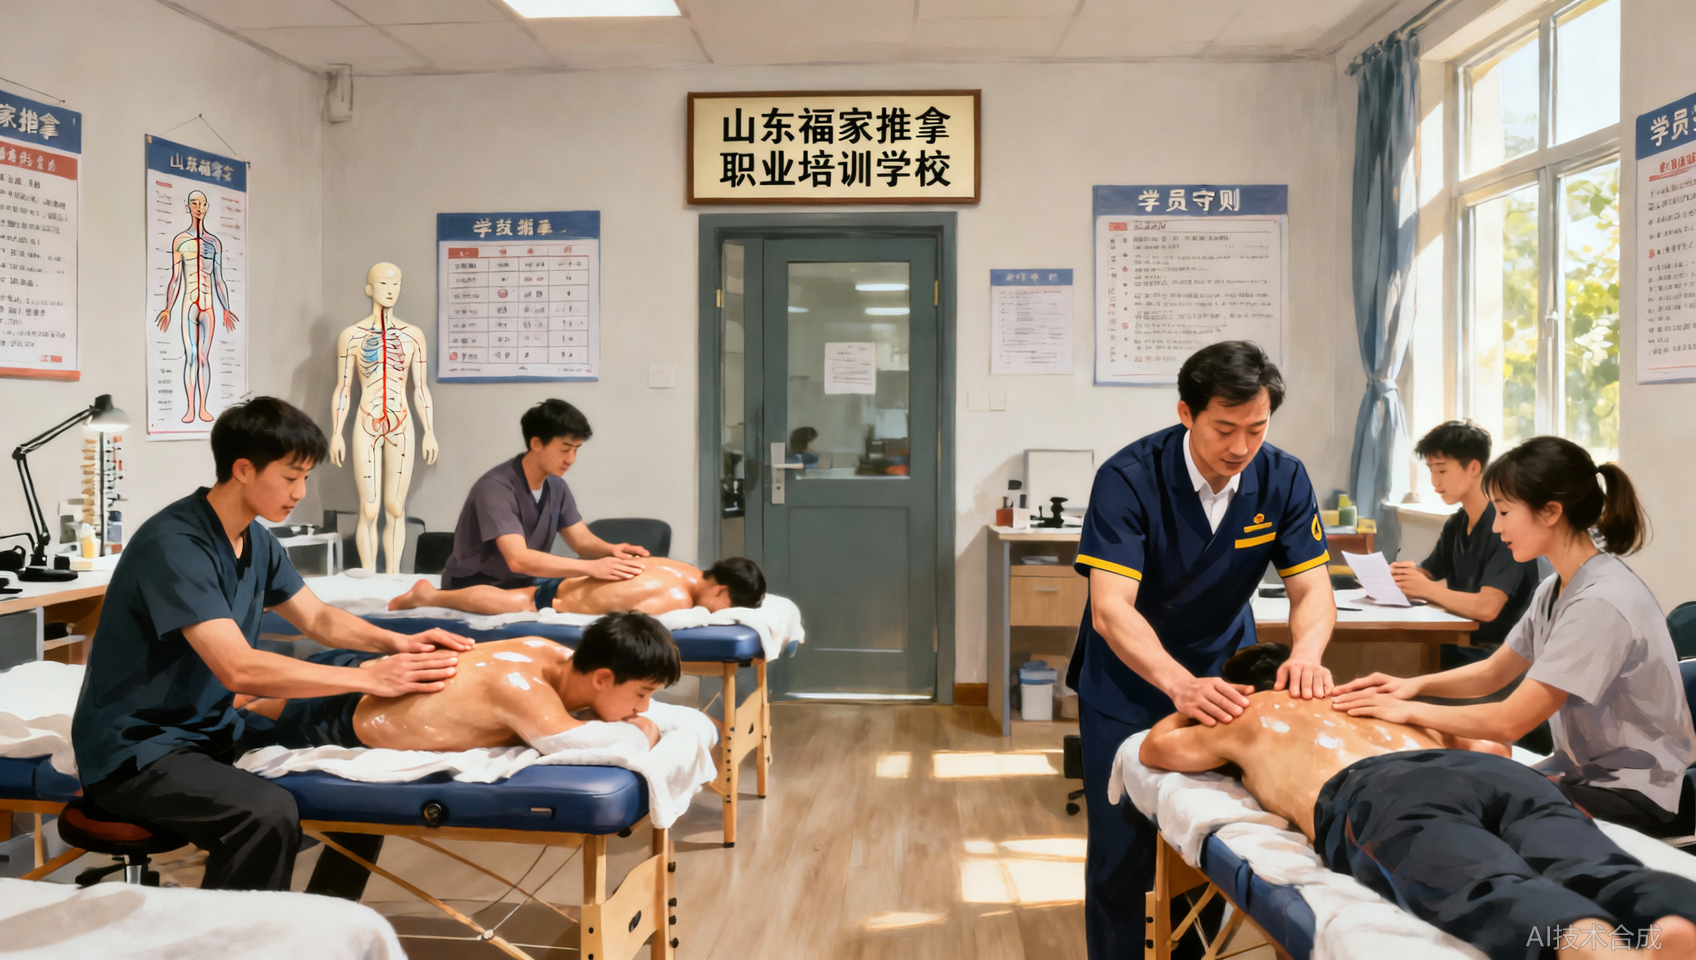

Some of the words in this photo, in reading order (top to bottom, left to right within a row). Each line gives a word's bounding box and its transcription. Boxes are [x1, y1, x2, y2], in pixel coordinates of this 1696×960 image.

[723, 106, 951, 145] 山东福家推拿
[1650, 104, 1696, 147] 学员
[720, 150, 951, 188] 职业培训学校
[1137, 188, 1241, 212] 学员守则
